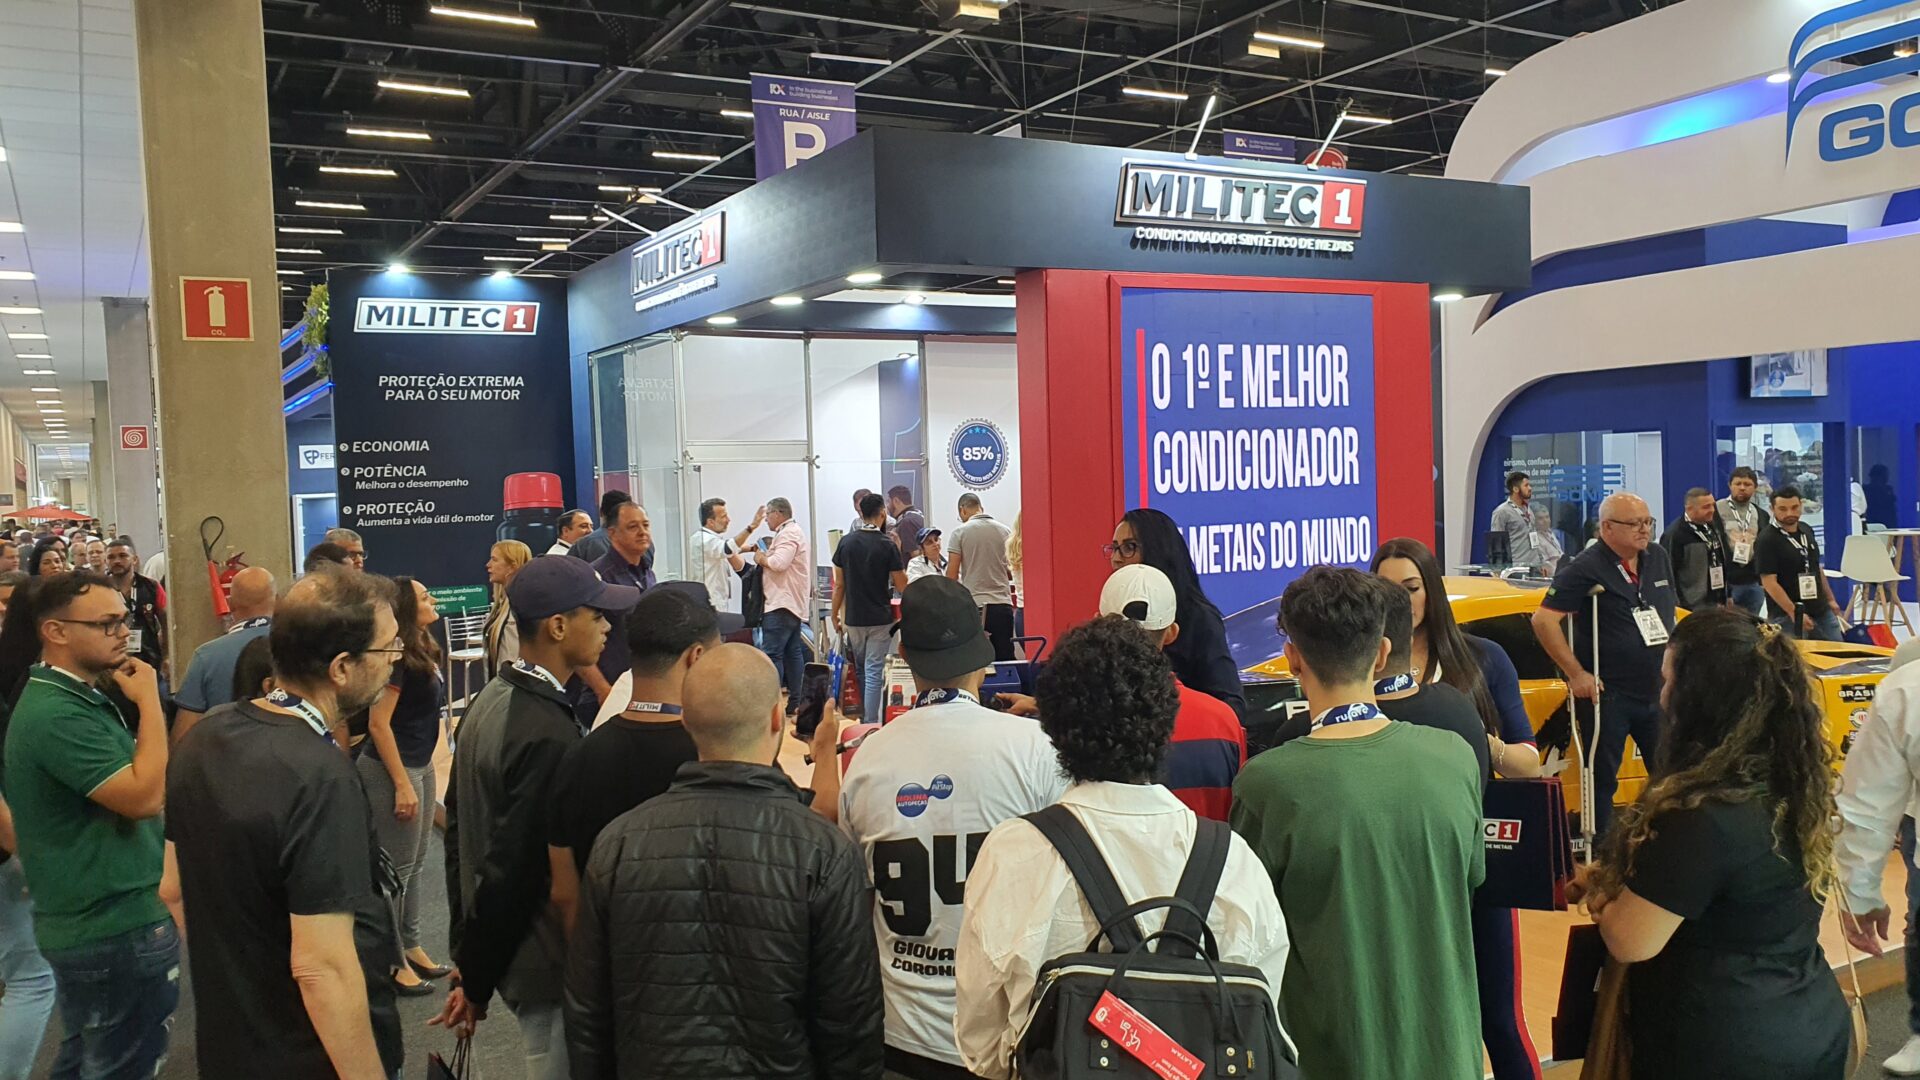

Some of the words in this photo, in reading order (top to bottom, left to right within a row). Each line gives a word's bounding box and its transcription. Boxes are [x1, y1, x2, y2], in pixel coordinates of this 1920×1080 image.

[779, 108, 800, 118] RUA
[807, 111, 831, 121] AISLE
[1131, 171, 1320, 225] MILITEC
[1333, 188, 1352, 225] 1
[1135, 226, 1237, 246] CONDICIONADOR
[1237, 230, 1298, 249] SINTÉTICO
[1297, 237, 1315, 250] DE
[1314, 238, 1355, 252] METAIS
[632, 229, 703, 290] MILITEC
[706, 222, 717, 259] 1
[366, 305, 502, 328] MILITEC
[512, 308, 527, 329] 1
[378, 373, 456, 389] PROTEÇÃO
[459, 376, 525, 387] EXTREMA
[1151, 342, 1171, 410] O
[1182, 343, 1210, 409] 1º
[1218, 343, 1235, 408] E
[1242, 344, 1350, 408] MELHOR
[385, 389, 425, 401] PARA
[427, 389, 438, 401] O
[440, 389, 468, 401] SEU
[470, 390, 521, 401] MOTOR
[352, 440, 430, 453] ECONOMIA
[962, 446, 995, 461] 85%
[320, 452, 336, 460] FER
[1153, 426, 1360, 495] CONDICIONADOR
[354, 463, 427, 478] POTÊNCIA
[355, 480, 397, 490] Melhora
[406, 479, 470, 489] desempenho
[356, 500, 435, 516] PROTEÇÃO
[356, 517, 402, 527] Aumenta
[412, 515, 433, 525] vida
[434, 514, 450, 524] útil
[451, 514, 464, 523] do
[464, 513, 495, 523] motor
[1189, 522, 1266, 575] METAIS
[1270, 520, 1297, 570] DO
[1302, 515, 1371, 567] MUNDO
[1838, 689, 1875, 698] BRASI
[1504, 825, 1513, 838] 1
[891, 957, 956, 977] CORON
